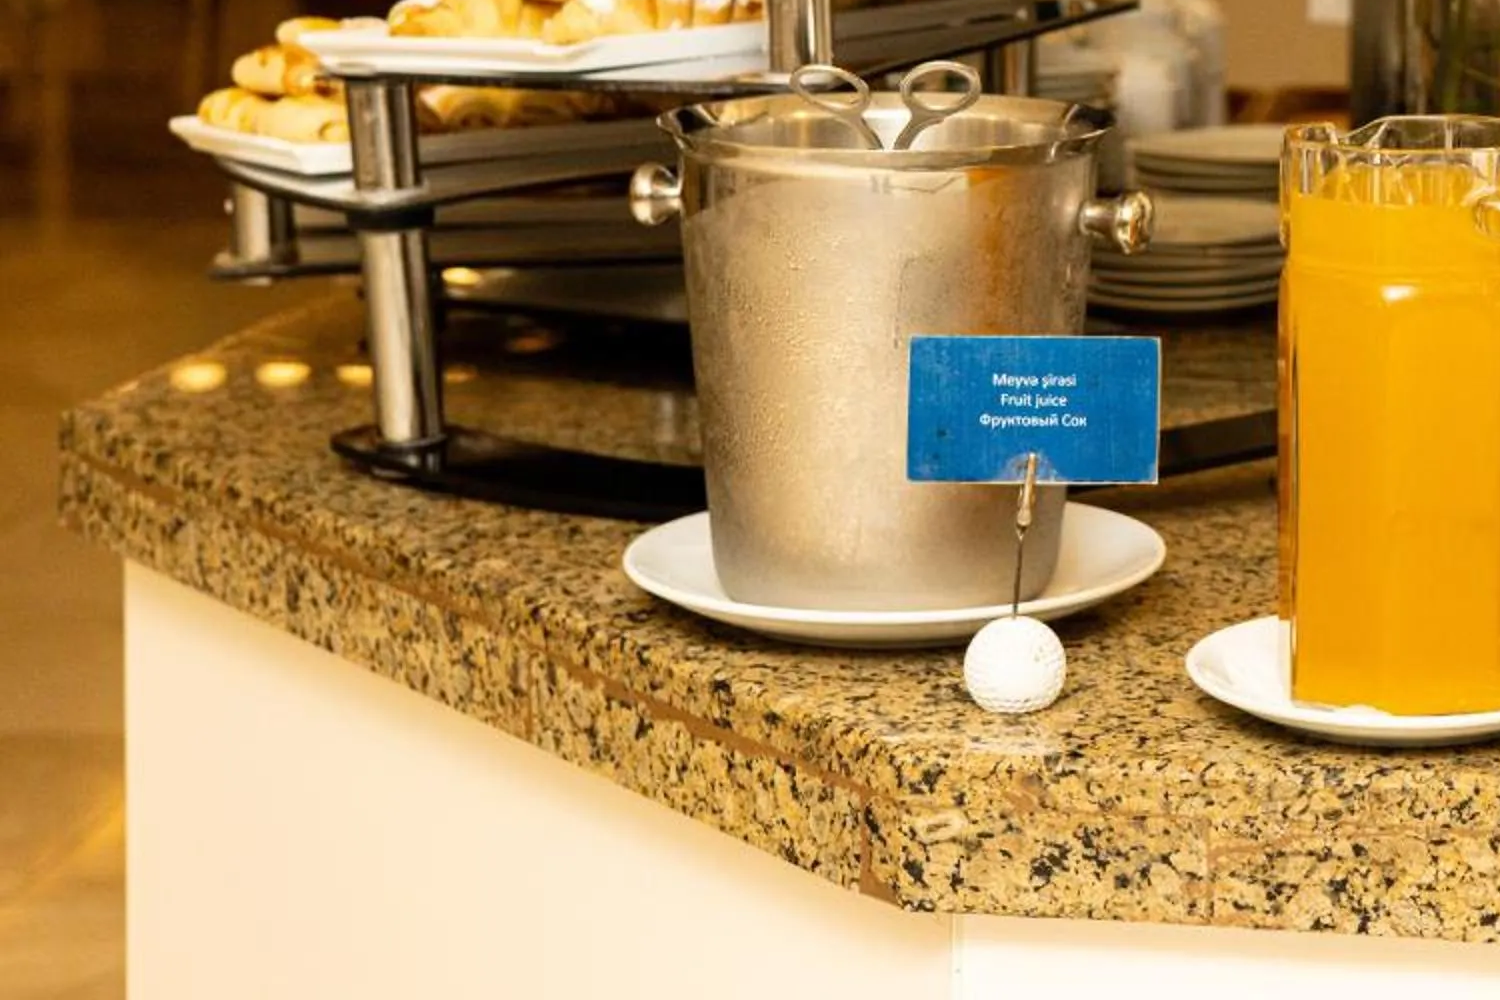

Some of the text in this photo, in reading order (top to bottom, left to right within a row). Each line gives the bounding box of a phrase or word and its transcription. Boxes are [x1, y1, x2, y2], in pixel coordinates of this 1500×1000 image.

[1000, 393, 1068, 408] Fruit juice
[979, 413, 1087, 428] Фруктовый Сок
